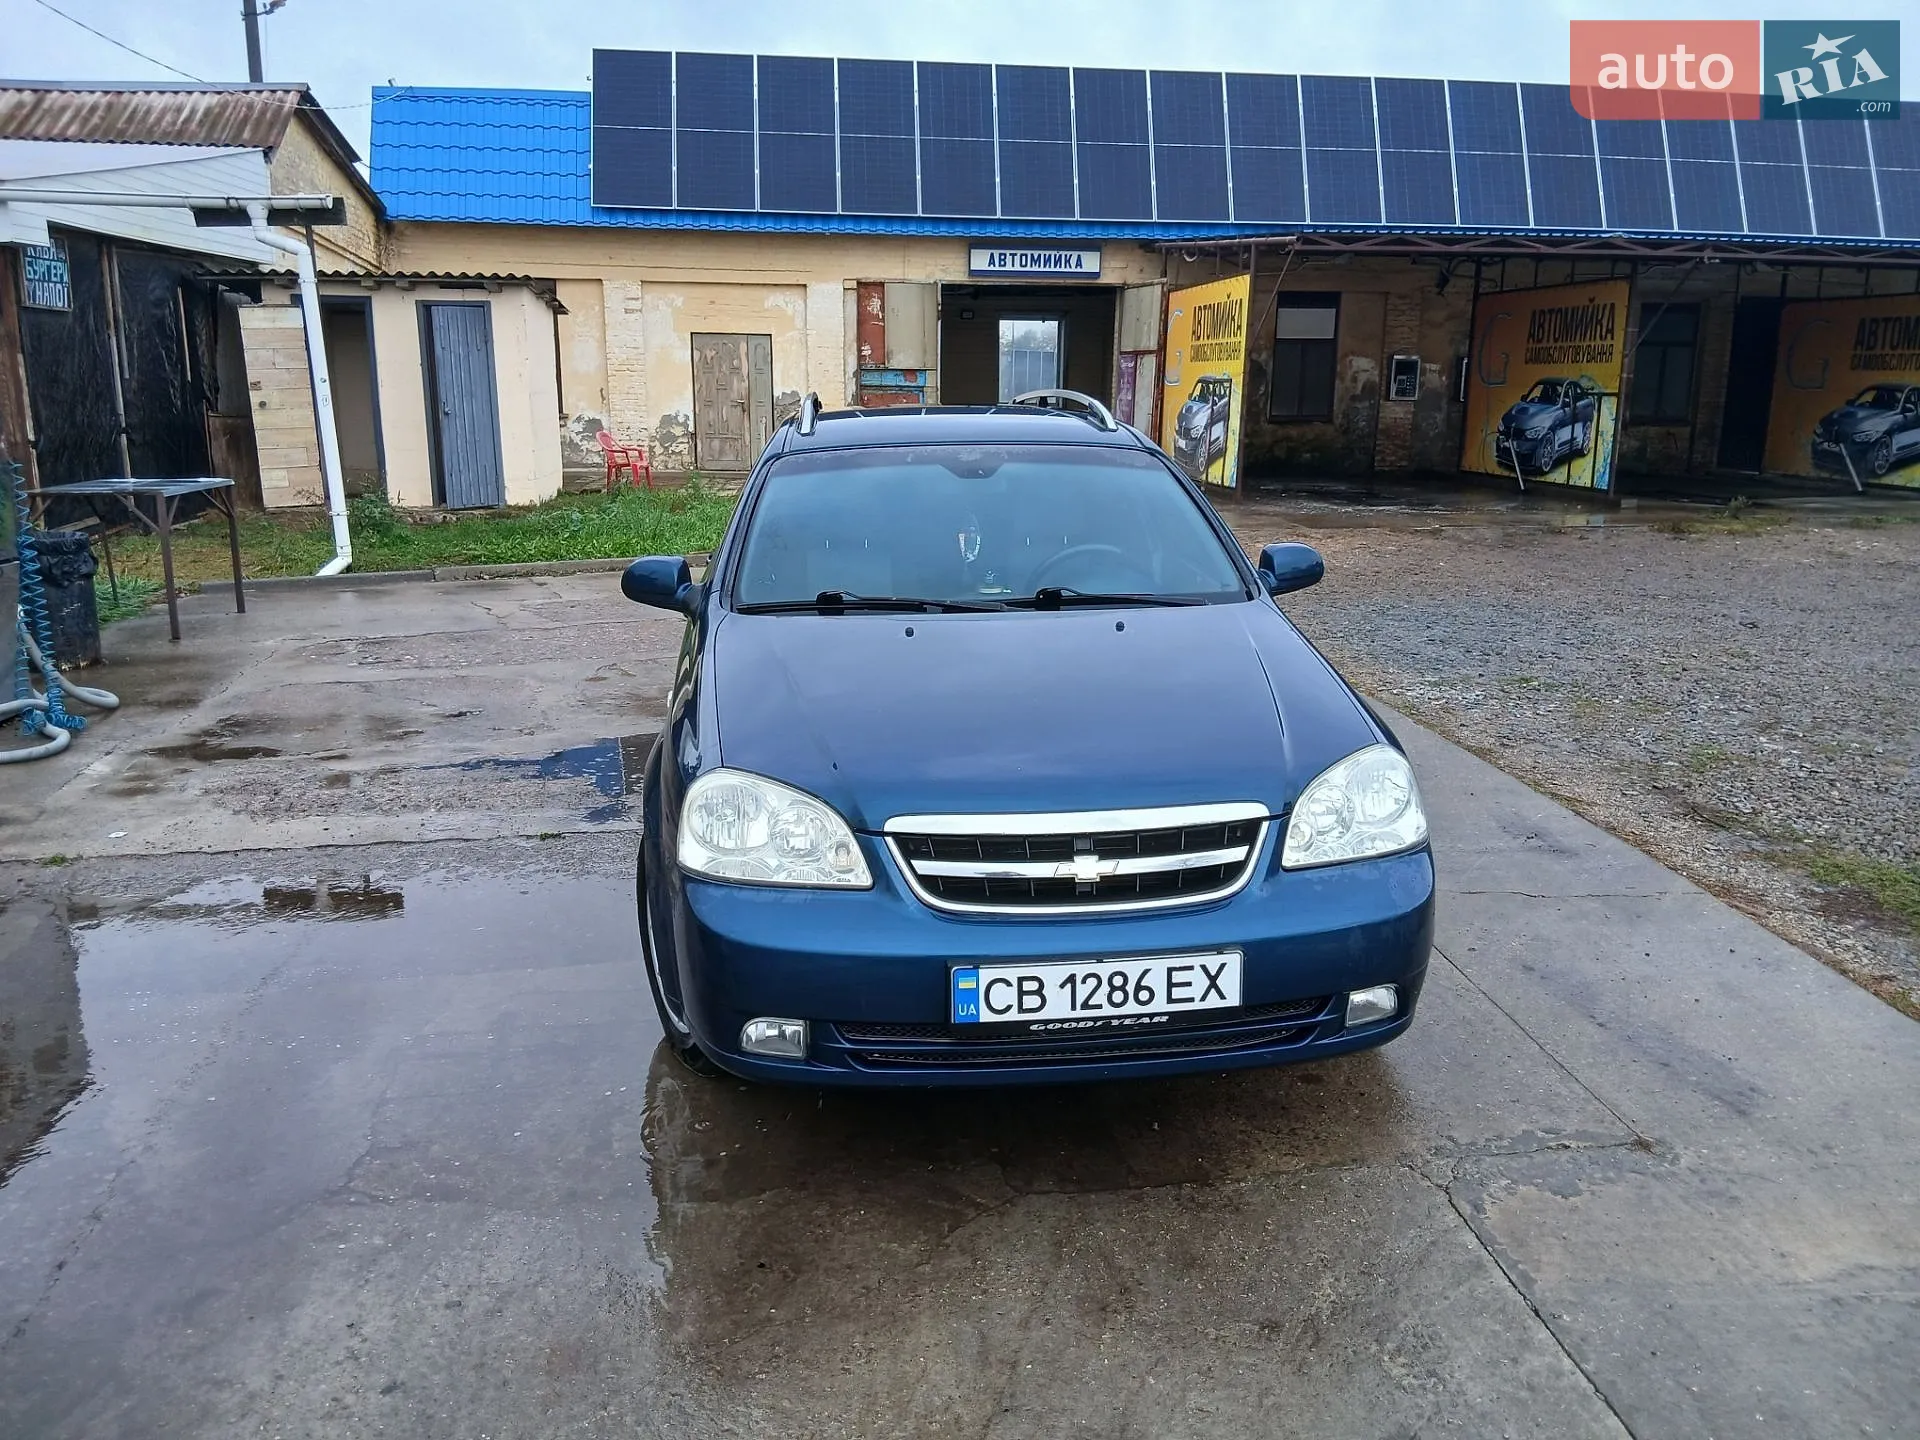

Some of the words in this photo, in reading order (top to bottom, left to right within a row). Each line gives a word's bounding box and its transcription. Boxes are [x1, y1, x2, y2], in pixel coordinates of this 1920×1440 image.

[24, 257, 69, 283] БУРГЕРИ
[987, 251, 1083, 269] АВТОМИЙКА
[35, 281, 69, 308] НАПОЇ
[1192, 292, 1243, 342] АВТОМИЙКА
[1527, 297, 1615, 344] АВТОМИЙКА
[1524, 344, 1614, 365] САМООБСЛУГОВУВАННЯ
[984, 975, 1047, 1016] CB
[1059, 968, 1156, 1012] 1286
[1166, 962, 1228, 1005] EX
[958, 1003, 977, 1016] UA
